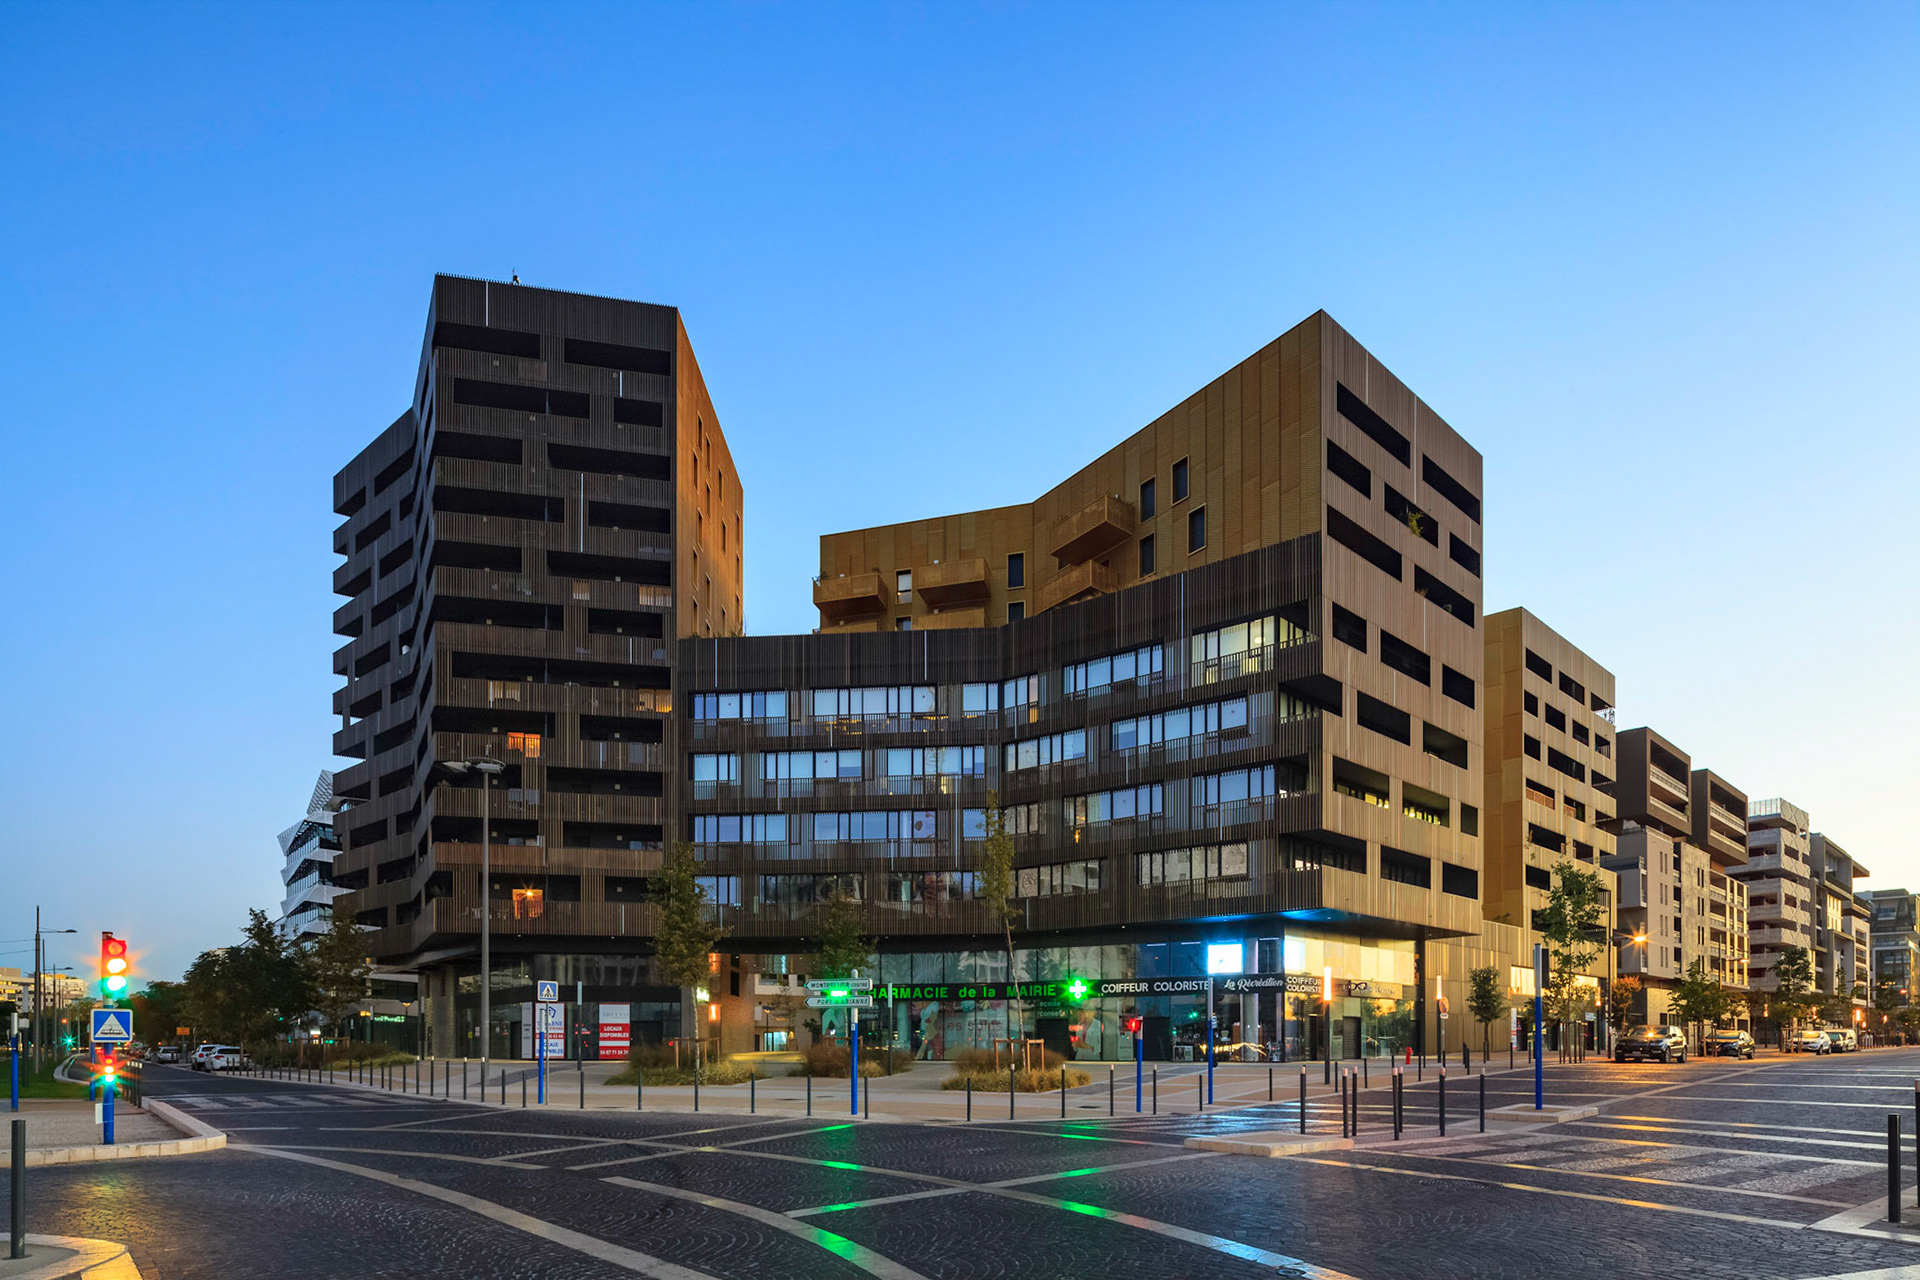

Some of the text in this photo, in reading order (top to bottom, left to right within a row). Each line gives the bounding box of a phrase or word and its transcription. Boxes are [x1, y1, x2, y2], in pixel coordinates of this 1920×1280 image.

[1224, 979, 1236, 990] La
[1286, 976, 1322, 985] COIFFEUR
[959, 986, 976, 998] de
[984, 986, 995, 998] la
[1006, 984, 1056, 997] MAIRIE
[1101, 981, 1208, 993] COIFFEUR COLORISTE
[1286, 984, 1322, 993] COLORISTE
